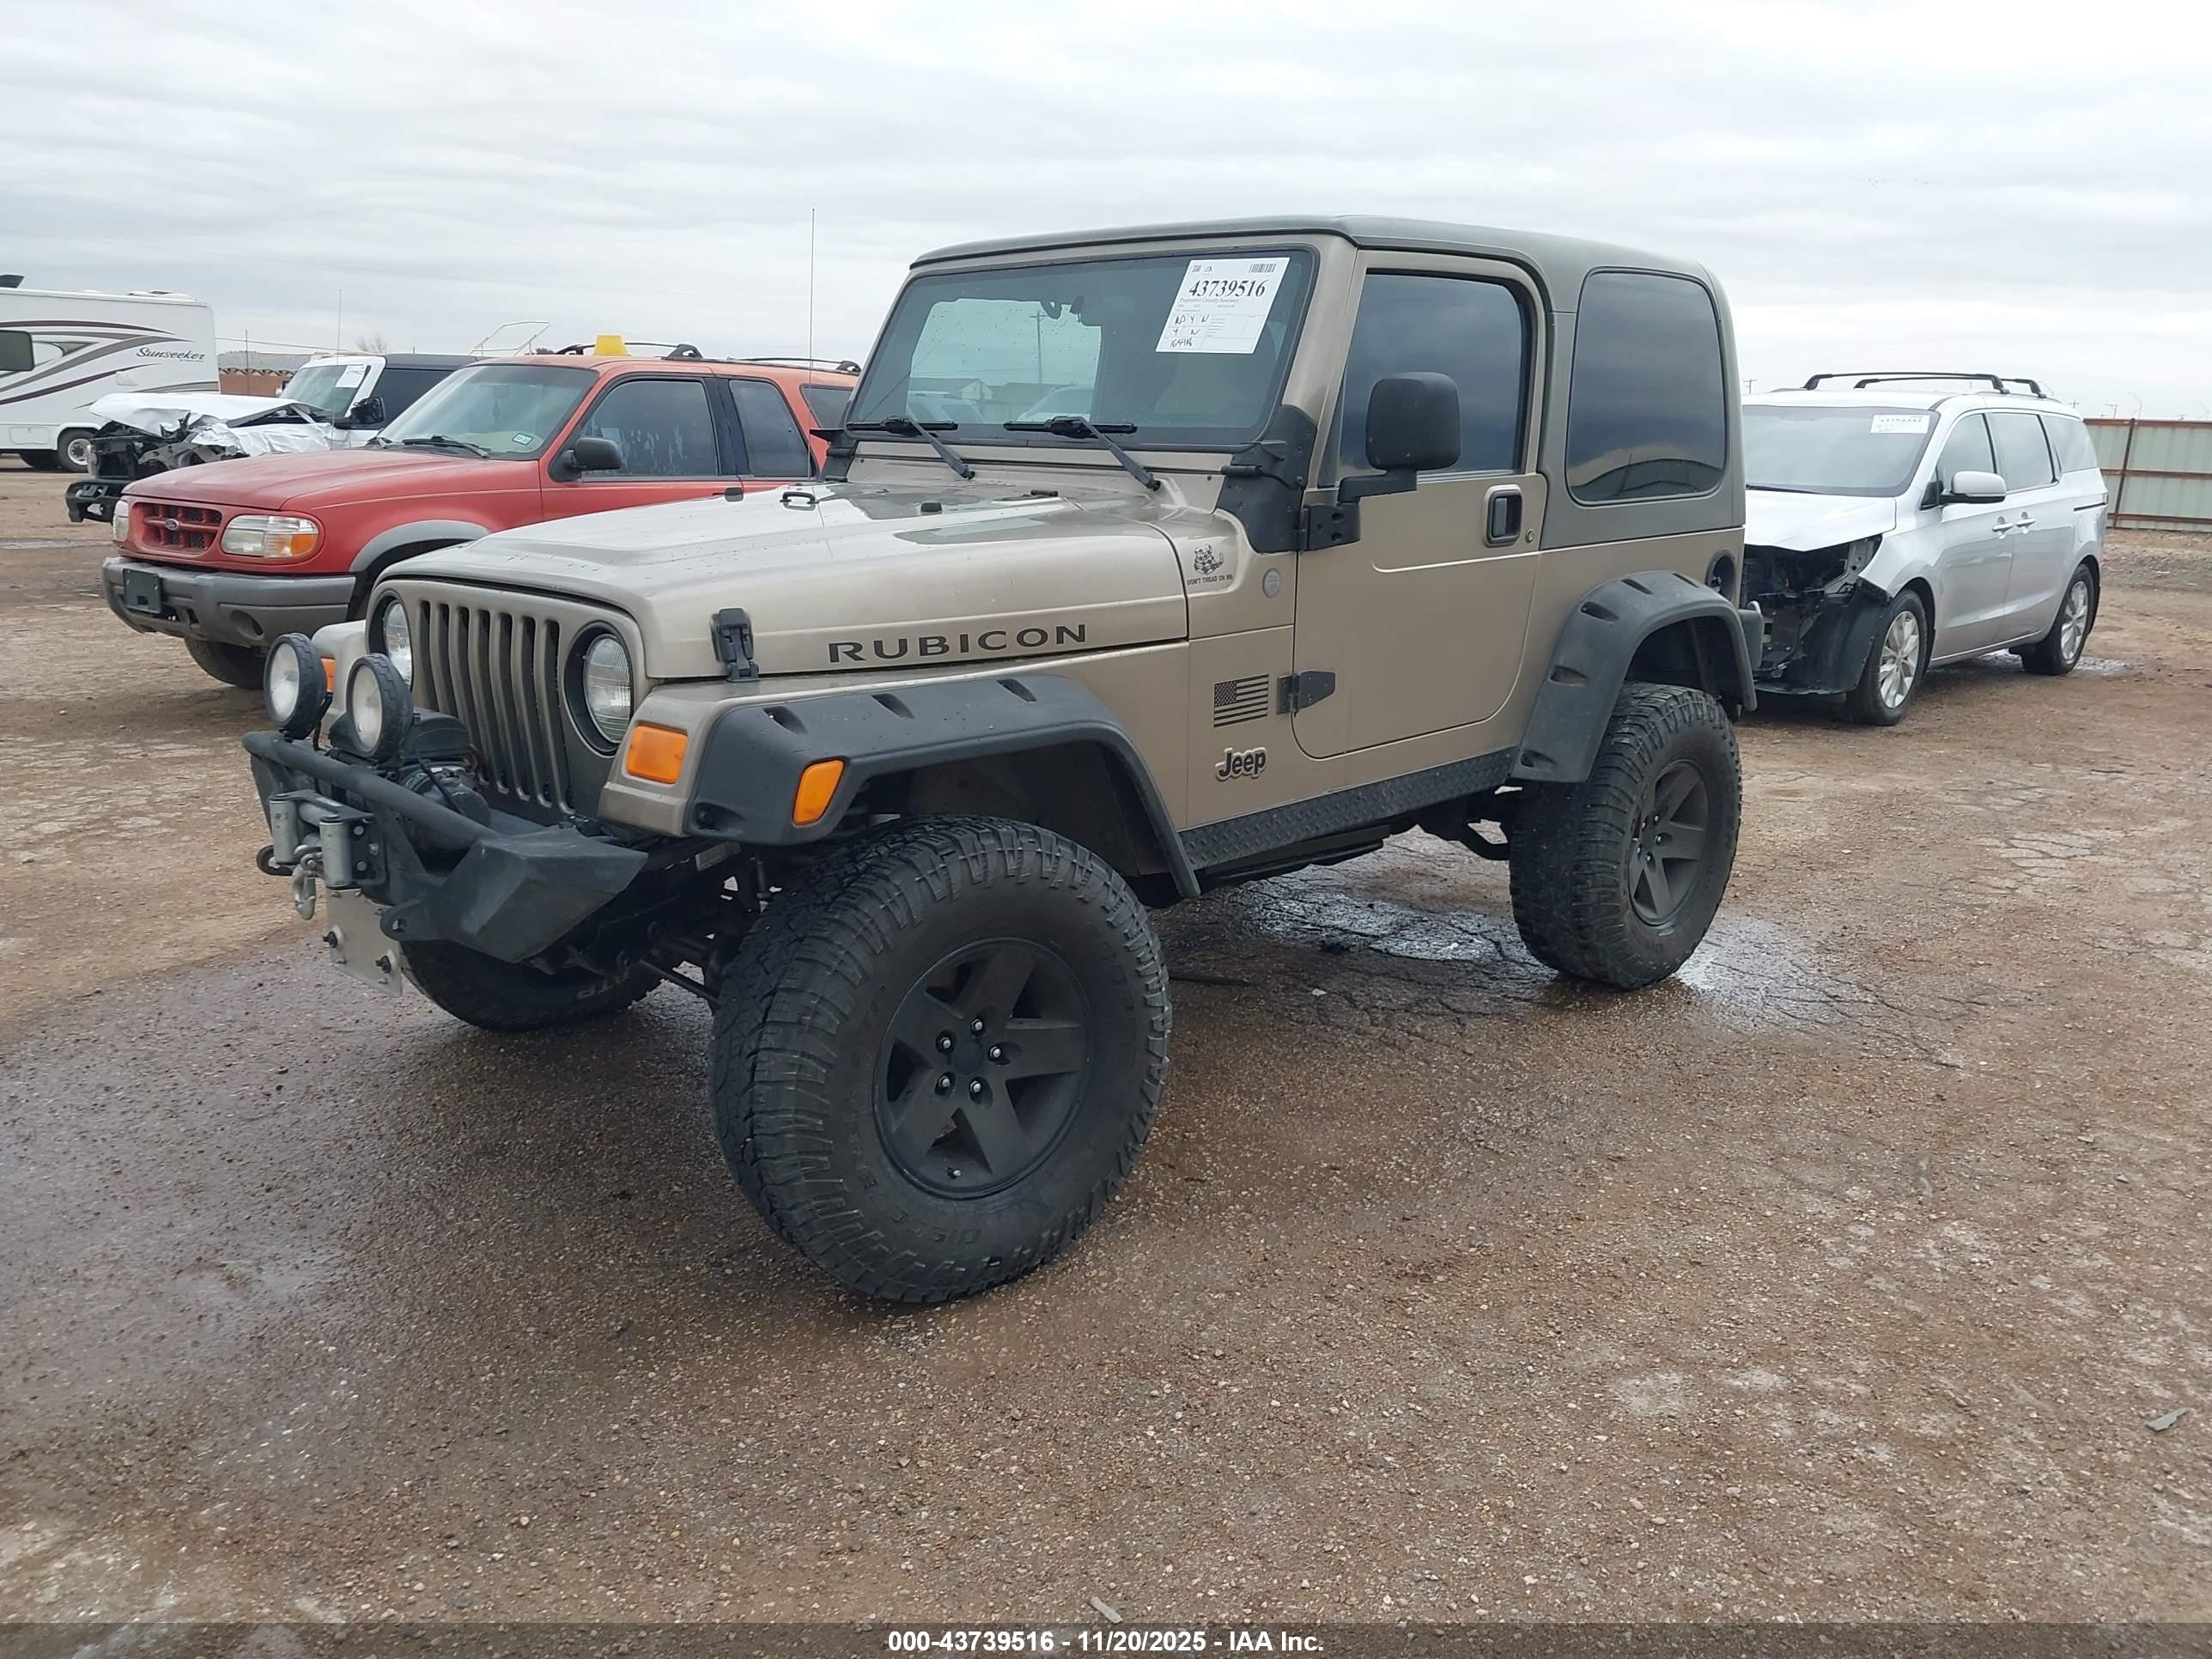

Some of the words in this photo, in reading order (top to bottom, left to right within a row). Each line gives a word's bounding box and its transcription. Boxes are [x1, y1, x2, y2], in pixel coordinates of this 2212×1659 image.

[1189, 279, 1268, 297] 43739516
[136, 347, 205, 360] Sunseeker
[828, 624, 1086, 663] RUBICON
[1216, 747, 1267, 781] Jeep
